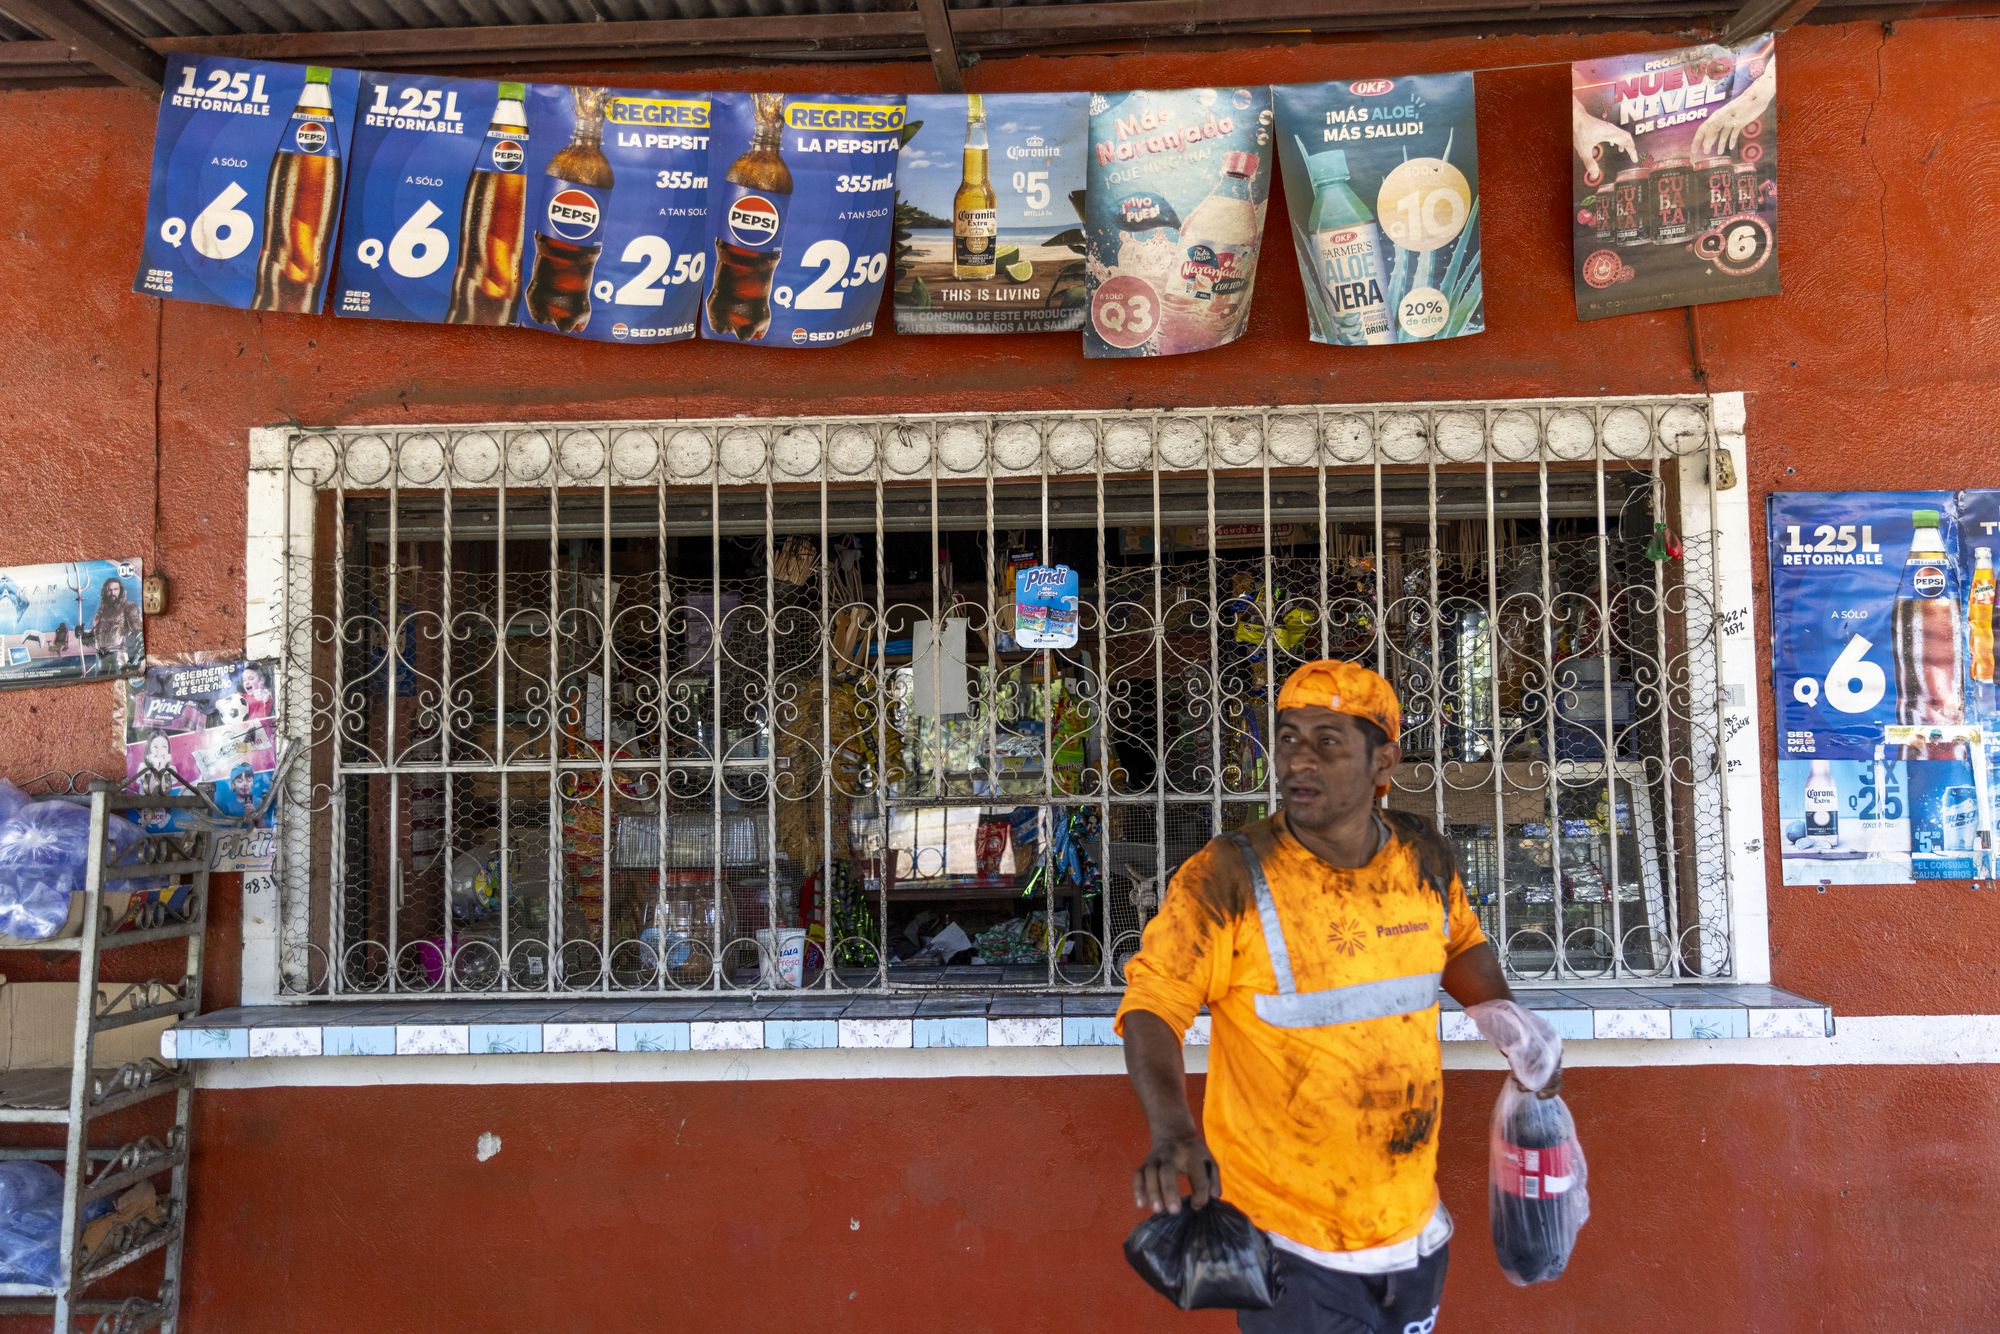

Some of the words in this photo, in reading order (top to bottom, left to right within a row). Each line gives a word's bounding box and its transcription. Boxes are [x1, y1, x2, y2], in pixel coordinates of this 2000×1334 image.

[178, 66, 250, 101] 1.25
[252, 74, 269, 103] L
[1357, 81, 1386, 94] OKF
[172, 94, 270, 116] RETORNABLE
[370, 85, 443, 120] 1.25
[444, 91, 462, 120] L
[1619, 80, 1726, 126] NIVEL
[612, 103, 710, 125] REGRES
[791, 108, 904, 128] REGRESÓ
[1326, 105, 1369, 125] ¡MÁS
[1371, 105, 1419, 121] ALOE,
[1634, 121, 1655, 136] DE
[1656, 107, 1708, 129] SABOR
[365, 114, 464, 134] RETORNABLE
[1323, 123, 1361, 142] MÁS
[1364, 121, 1424, 139] SALUD!
[298, 132, 325, 142] PEPSI
[618, 132, 642, 148] LA
[1095, 112, 1233, 167] Naranjada
[797, 137, 822, 153] LA
[825, 137, 900, 154] PEPSITA
[1006, 145, 1061, 160] Coronita
[211, 157, 219, 166] A
[221, 156, 248, 168] SÓLO
[494, 151, 522, 161] PEPSI
[415, 175, 443, 187] SÓLO
[551, 204, 596, 224] PEPSI
[659, 208, 667, 216] A
[668, 208, 687, 216] TAN
[838, 212, 846, 220] A
[847, 211, 866, 220] TAN
[866, 208, 888, 218] SOLO
[731, 211, 776, 229] PEPSI
[1334, 231, 1353, 243] OKF
[1322, 240, 1374, 260] FARMER'S
[148, 269, 173, 277] SED
[1324, 251, 1378, 285] ALOE
[146, 275, 163, 283] DE
[144, 281, 173, 293] MÁS
[345, 290, 371, 298] SED
[941, 289, 972, 301] THIS
[978, 288, 990, 301] IS
[996, 287, 1041, 301] LIVING
[1324, 278, 1384, 313] VERA
[342, 303, 370, 312] MÁS
[919, 311, 973, 322] CONSUMO
[976, 311, 991, 321] DE
[993, 311, 1021, 321] ESTE
[1023, 307, 1082, 320] PRODUCTO
[1405, 300, 1443, 317] 20%
[1421, 313, 1444, 324] aloe
[630, 328, 656, 338] SED
[657, 327, 673, 337] DE
[673, 322, 695, 335] MÁS
[808, 332, 835, 342] SED
[836, 330, 850, 339] DE
[851, 321, 872, 336] MÁS
[897, 323, 933, 334] CAUSA
[935, 322, 975, 334] SERIOS
[977, 320, 1014, 333] DAÑOS
[1016, 322, 1025, 332] A
[1027, 320, 1041, 331] LA
[1365, 322, 1390, 335] DRINK
[1786, 525, 1857, 553] 1.25
[1862, 525, 1880, 552] L
[1783, 554, 1884, 565] RETORNABLE
[119, 566, 135, 577] DC
[1024, 568, 1067, 592] Pindi
[1916, 578, 1944, 586] PEPSI
[1831, 610, 1839, 619] A
[1841, 609, 1868, 619] SÓLO
[146, 699, 184, 718] Pindi
[1787, 744, 1816, 753] MÁS
[210, 832, 273, 870] Pndi
[1930, 860, 1970, 869] CONSUMO
[1913, 871, 1941, 879] CAUSA
